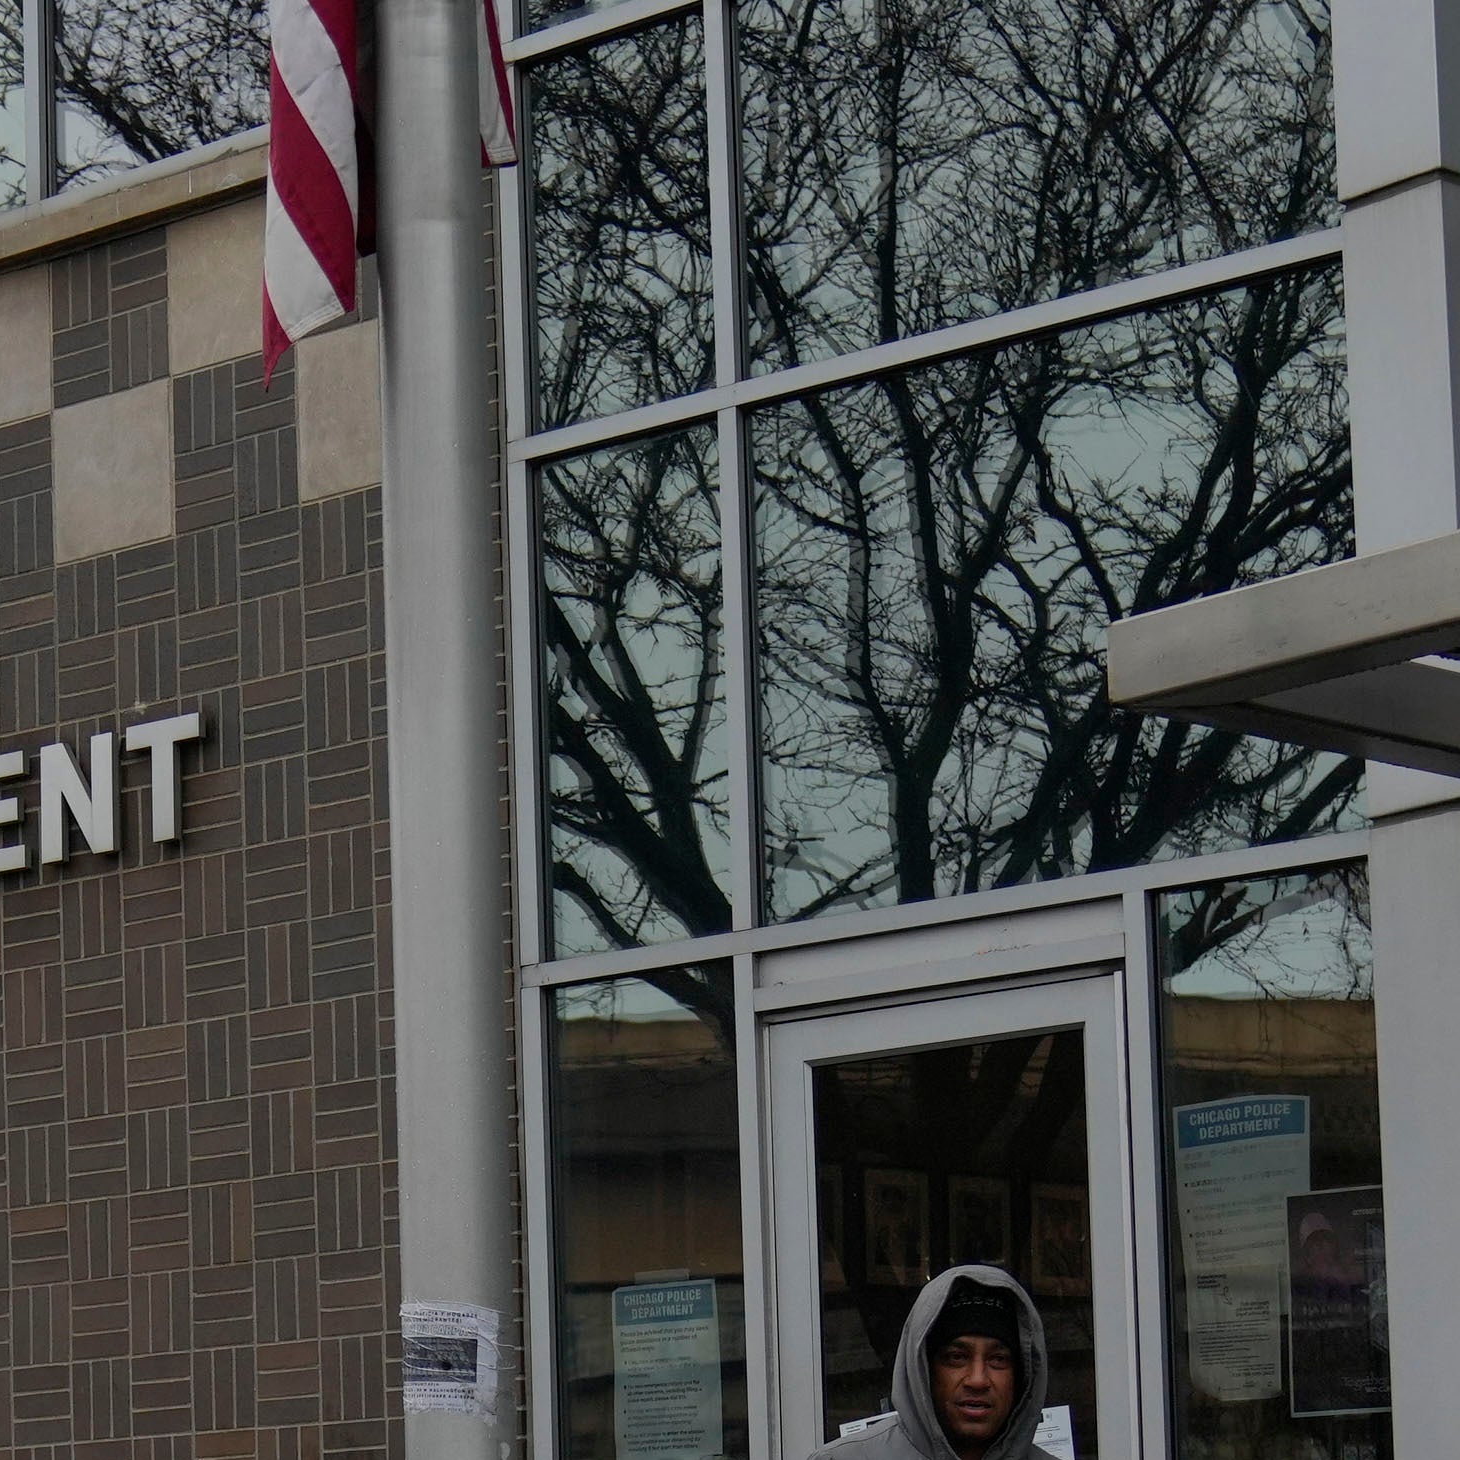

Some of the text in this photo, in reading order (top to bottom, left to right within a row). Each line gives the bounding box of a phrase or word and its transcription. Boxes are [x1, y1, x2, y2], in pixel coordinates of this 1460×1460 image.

[1189, 1103, 1291, 1127] CHICAGO POLICE
[1199, 1118, 1281, 1140] DEPARTMENT
[623, 1288, 702, 1306] CHICAGO POLICE
[631, 1304, 694, 1319] DEPARTMENT
